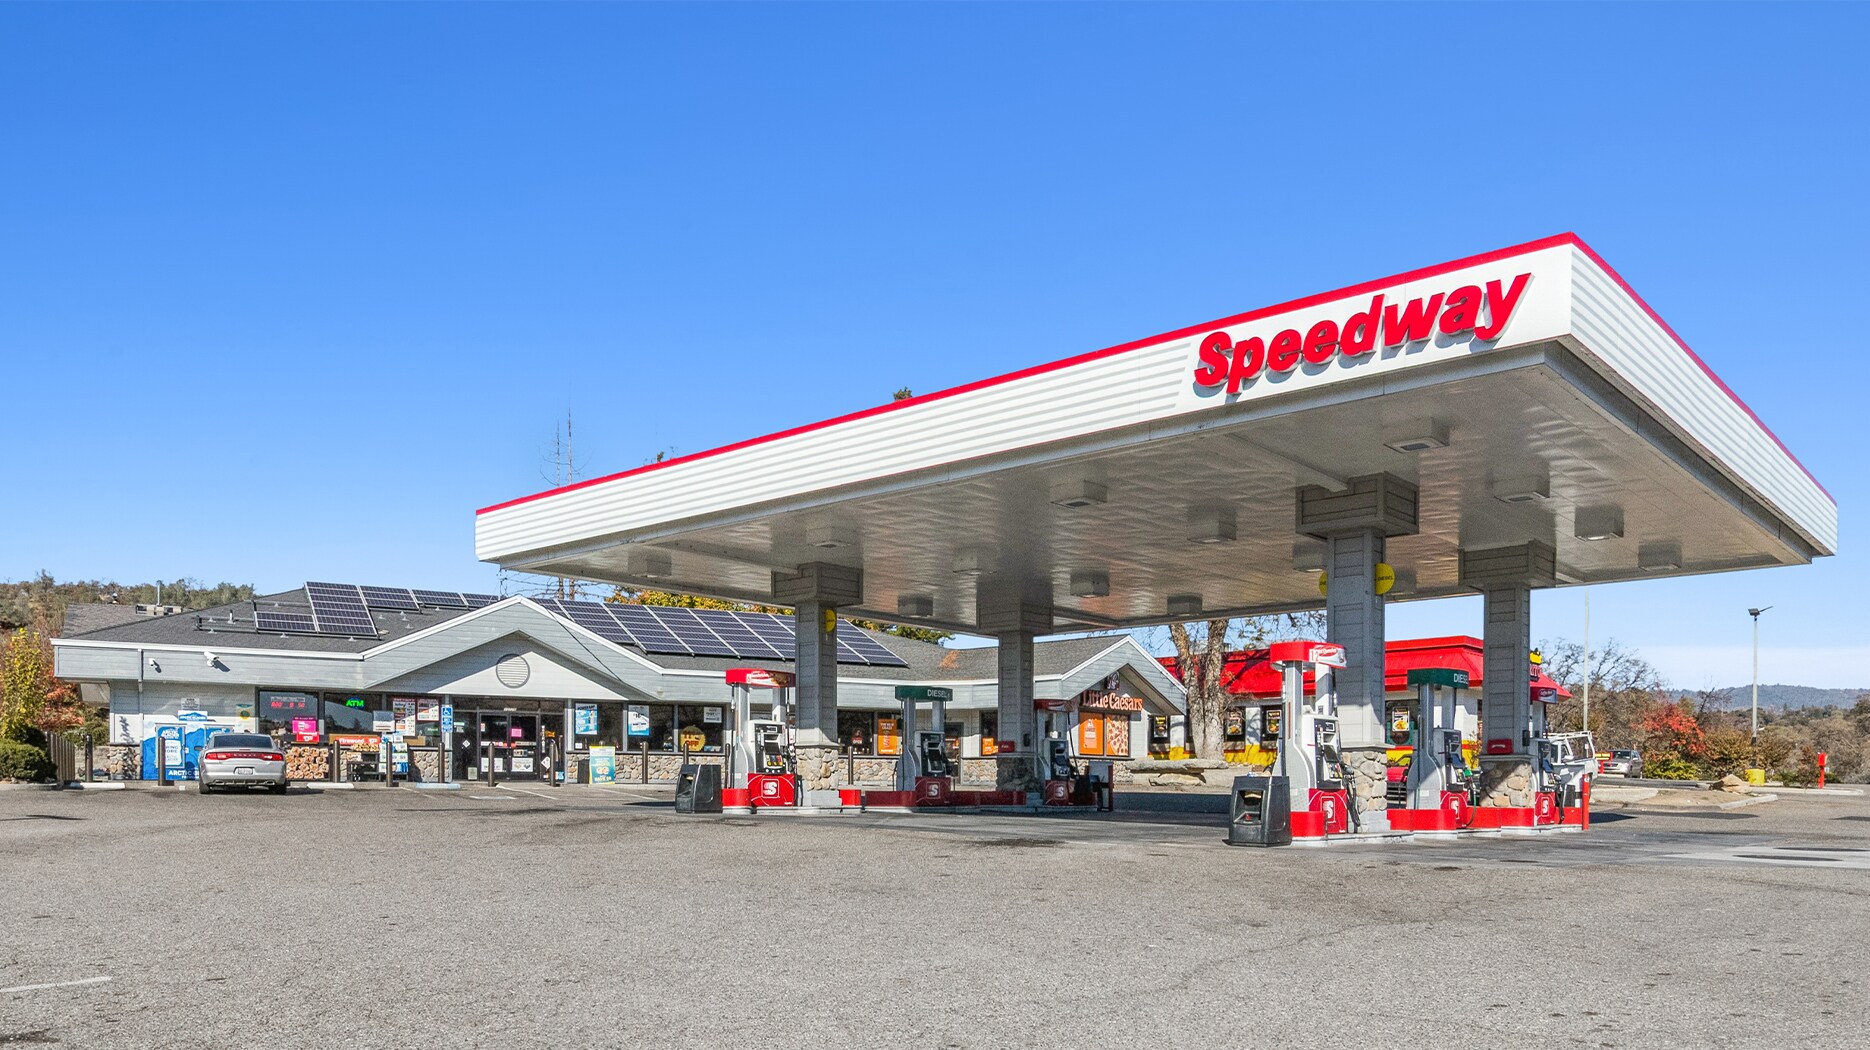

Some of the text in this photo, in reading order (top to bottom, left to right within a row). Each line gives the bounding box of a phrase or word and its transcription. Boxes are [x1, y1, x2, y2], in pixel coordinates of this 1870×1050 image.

[1194, 272, 1532, 394] Speedway
[927, 689, 947, 698] DIESEL
[1082, 690, 1143, 711] Little Caesars
